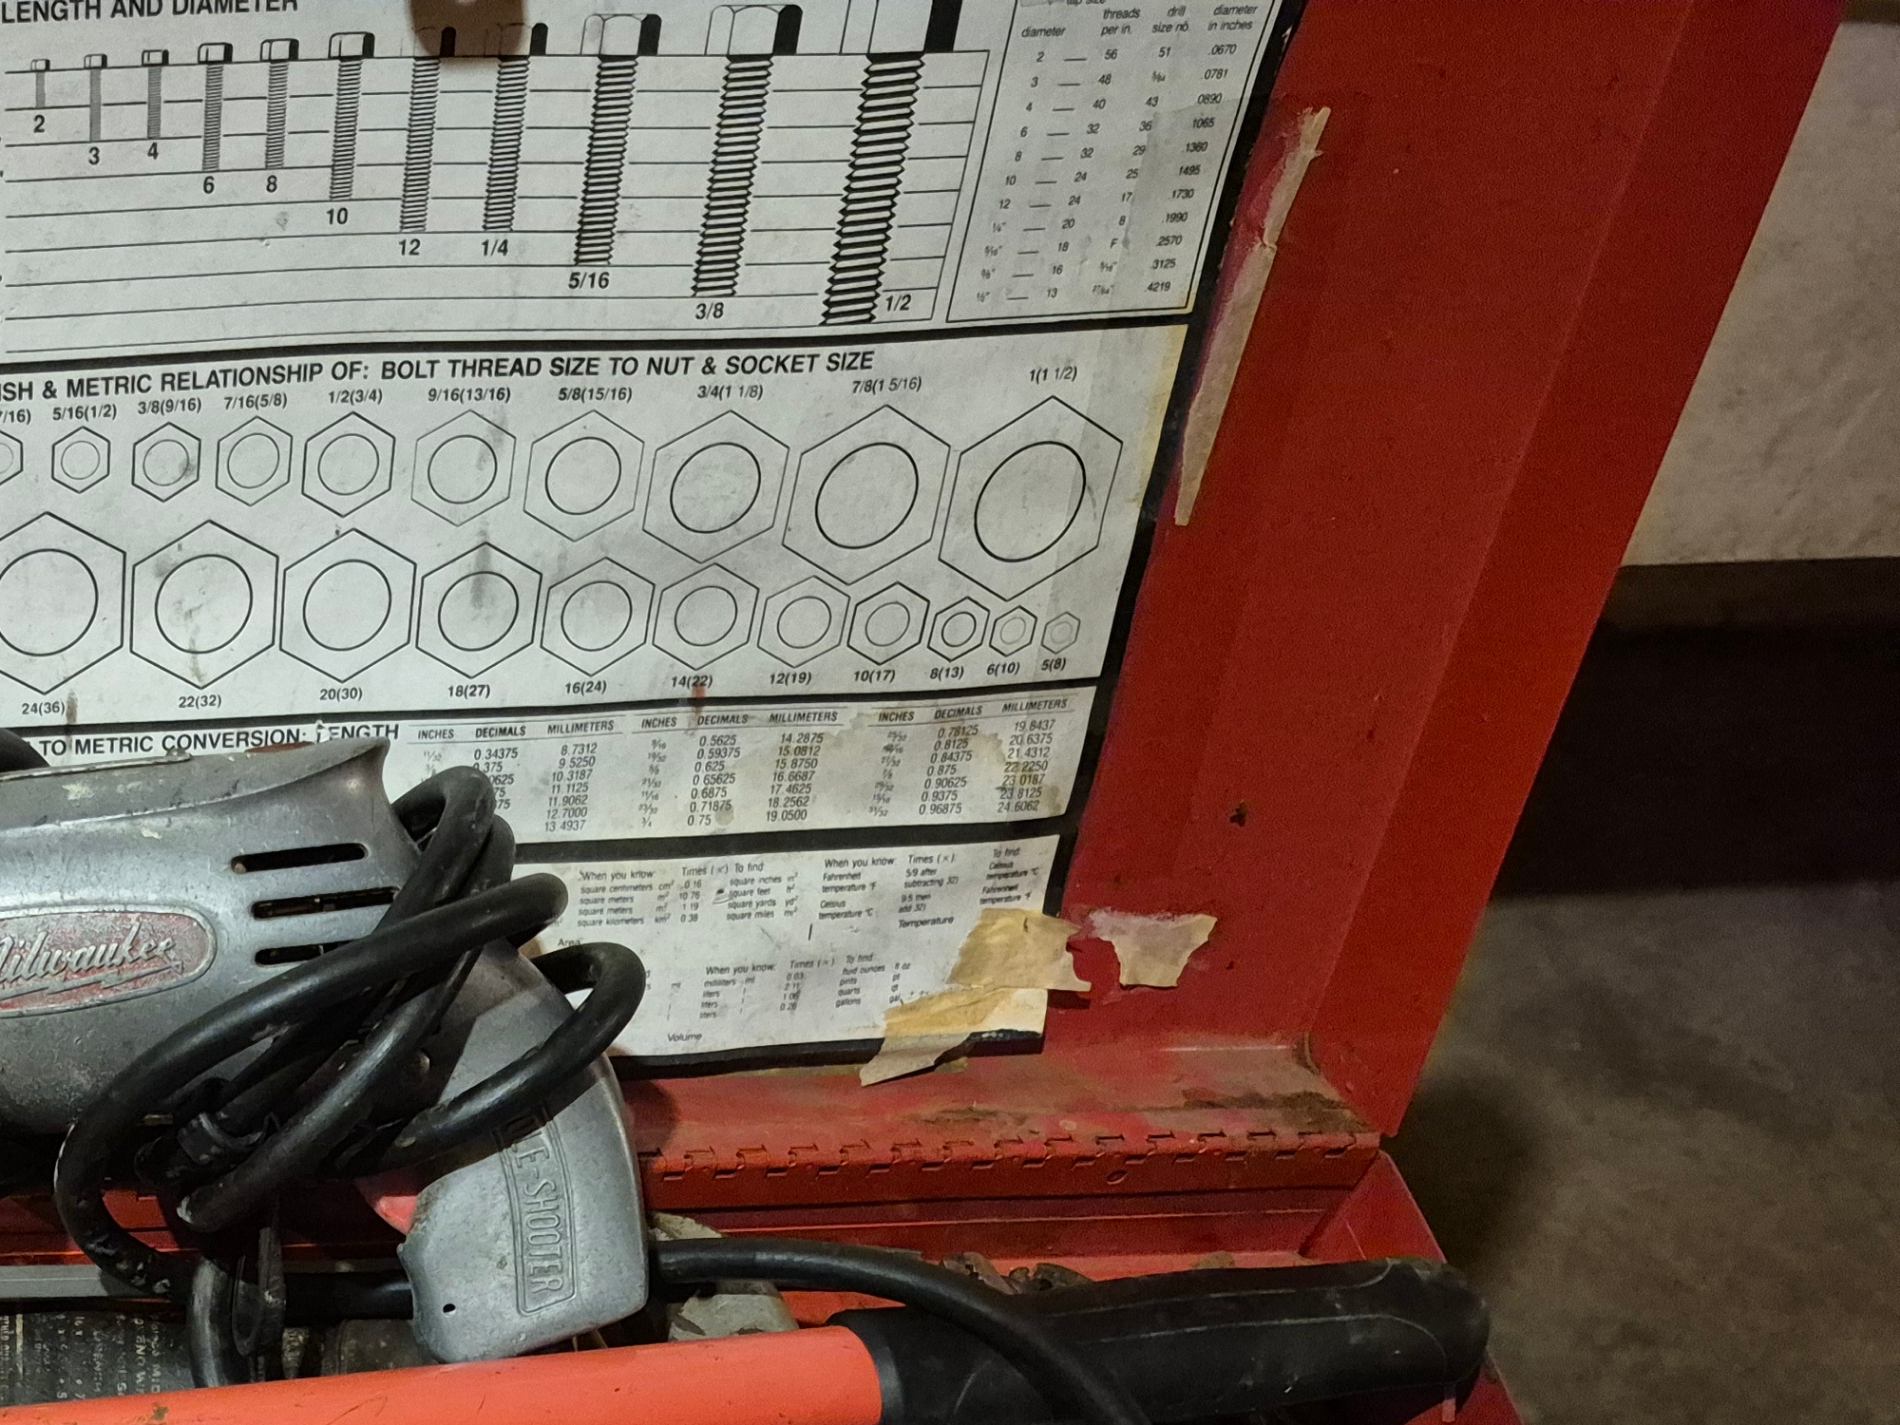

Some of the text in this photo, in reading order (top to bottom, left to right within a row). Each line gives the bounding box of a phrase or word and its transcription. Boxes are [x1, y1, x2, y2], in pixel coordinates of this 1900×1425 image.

[0, 0, 100, 23] LENGTH
[110, 0, 163, 18] AND
[1021, 26, 1066, 38] diameter
[33, 115, 46, 133] 2
[88, 147, 100, 165] 3
[147, 142, 159, 160] 4
[203, 176, 215, 194] 6
[266, 175, 278, 193] 8
[326, 207, 349, 226] 10
[399, 238, 421, 255] 12
[480, 236, 508, 257] 1/4
[568, 270, 610, 290] 5/16
[695, 302, 724, 320] 3/8
[885, 294, 911, 312] 1/2
[42, 380, 57, 399] &
[67, 374, 153, 398] METRIC
[160, 361, 323, 392] RELATIONSHIP
[330, 361, 369, 381] OF:
[381, 359, 440, 380] BOLT
[448, 357, 542, 378] THREAD
[549, 357, 601, 377] SIZE
[609, 356, 640, 376] TO
[646, 355, 695, 376] NUT
[701, 357, 717, 374] &
[725, 353, 819, 375] SOCKET
[826, 350, 875, 372] SIZE
[223, 393, 288, 410] 7/16(5/8)
[328, 388, 383, 404] 1/2(3/4)
[428, 386, 511, 403] 9/16(13/16)
[557, 386, 633, 403] 5/8(15/16)
[52, 403, 117, 421] 5/16(1/2)
[138, 398, 202, 415] 3/8(9/16)
[929, 666, 965, 681] 8(13)
[986, 661, 1021, 676] 6(10)
[1040, 657, 1066, 673] 5(8)
[671, 674, 713, 690] 14(22)
[768, 671, 812, 686] 12(19)
[853, 668, 896, 683] 10(17)
[319, 686, 363, 702] 20(30)
[447, 683, 491, 699] 18(27)
[564, 680, 607, 696] 16(24)
[21, 700, 66, 717] 24(36)
[178, 693, 222, 710] 22(32)
[1002, 698, 1068, 713] MILLIMETERS
[697, 714, 748, 726] DECIMALS
[768, 711, 838, 723] MILLIMETERS
[878, 711, 914, 722] INCHES
[934, 705, 983, 719] DECIMALS
[547, 720, 614, 735] MILLIMETERS
[641, 717, 678, 728] INCHES
[39, 723, 400, 757] TO METRIC CONVERSION: ENGTH
[417, 728, 454, 740] INCHES
[475, 725, 526, 738] DECIMALS
[824, 858, 849, 868] When
[852, 859, 868, 869] you
[505, 1113, 566, 1295] OLE-SHOOTER
